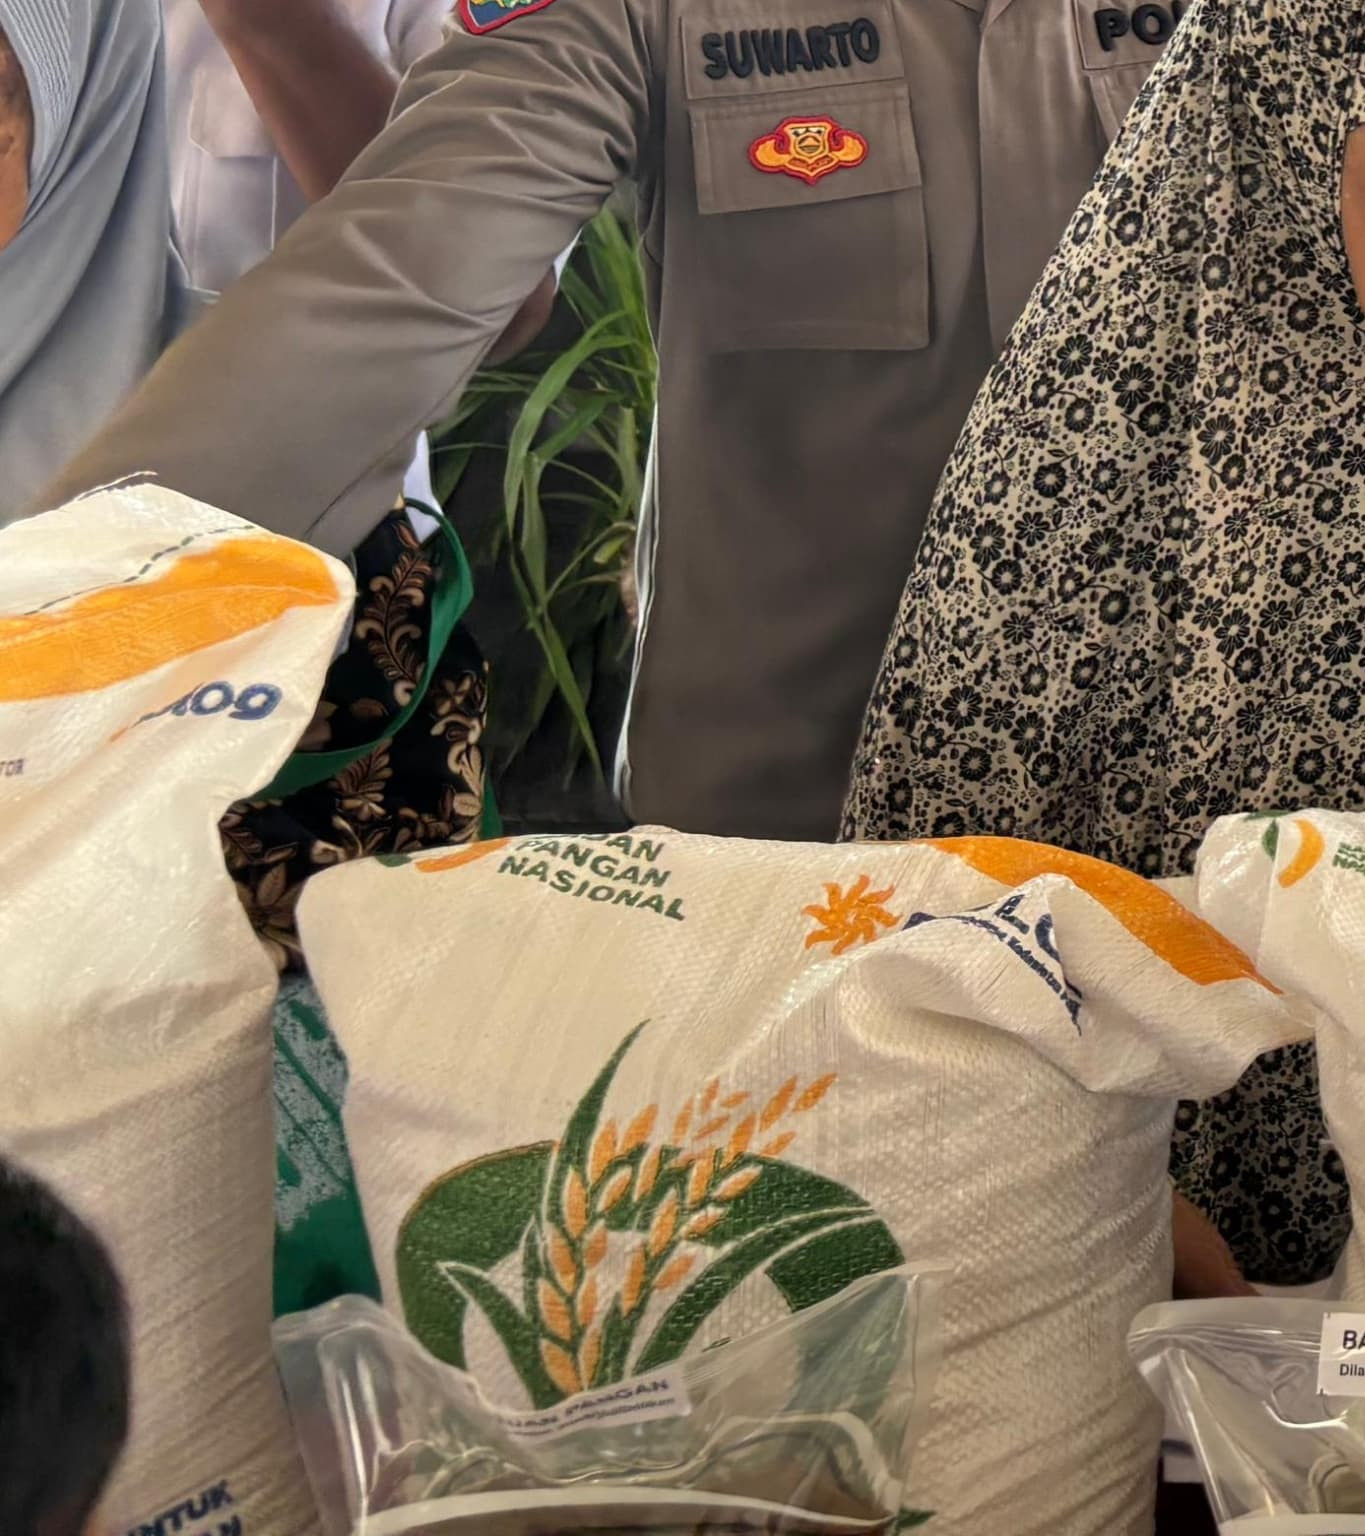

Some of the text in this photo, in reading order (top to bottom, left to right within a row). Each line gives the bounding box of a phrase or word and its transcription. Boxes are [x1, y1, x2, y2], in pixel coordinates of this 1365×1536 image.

[702, 17, 880, 80] SUWARTO
[497, 855, 685, 921] NASIONAL
[515, 840, 671, 887] PANGAN
